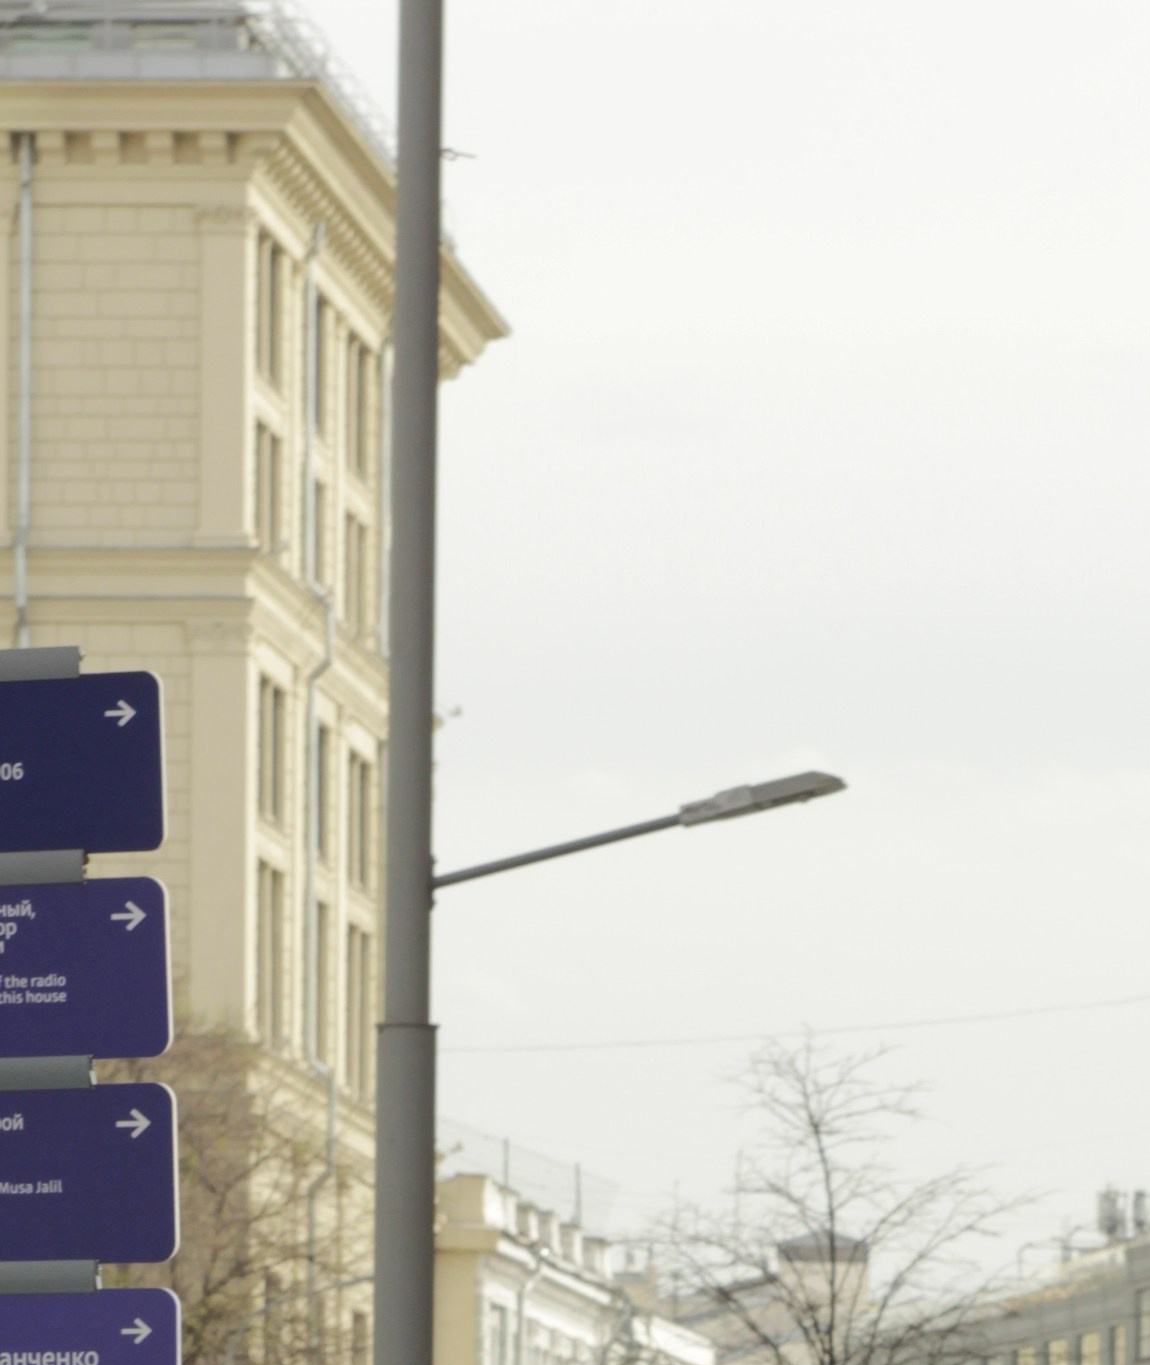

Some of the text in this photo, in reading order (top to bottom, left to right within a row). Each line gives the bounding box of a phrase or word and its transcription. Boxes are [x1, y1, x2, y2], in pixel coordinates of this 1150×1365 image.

[30, 973, 67, 987] radio
[25, 990, 68, 1003] house
[35, 1180, 63, 1194] Jalil
